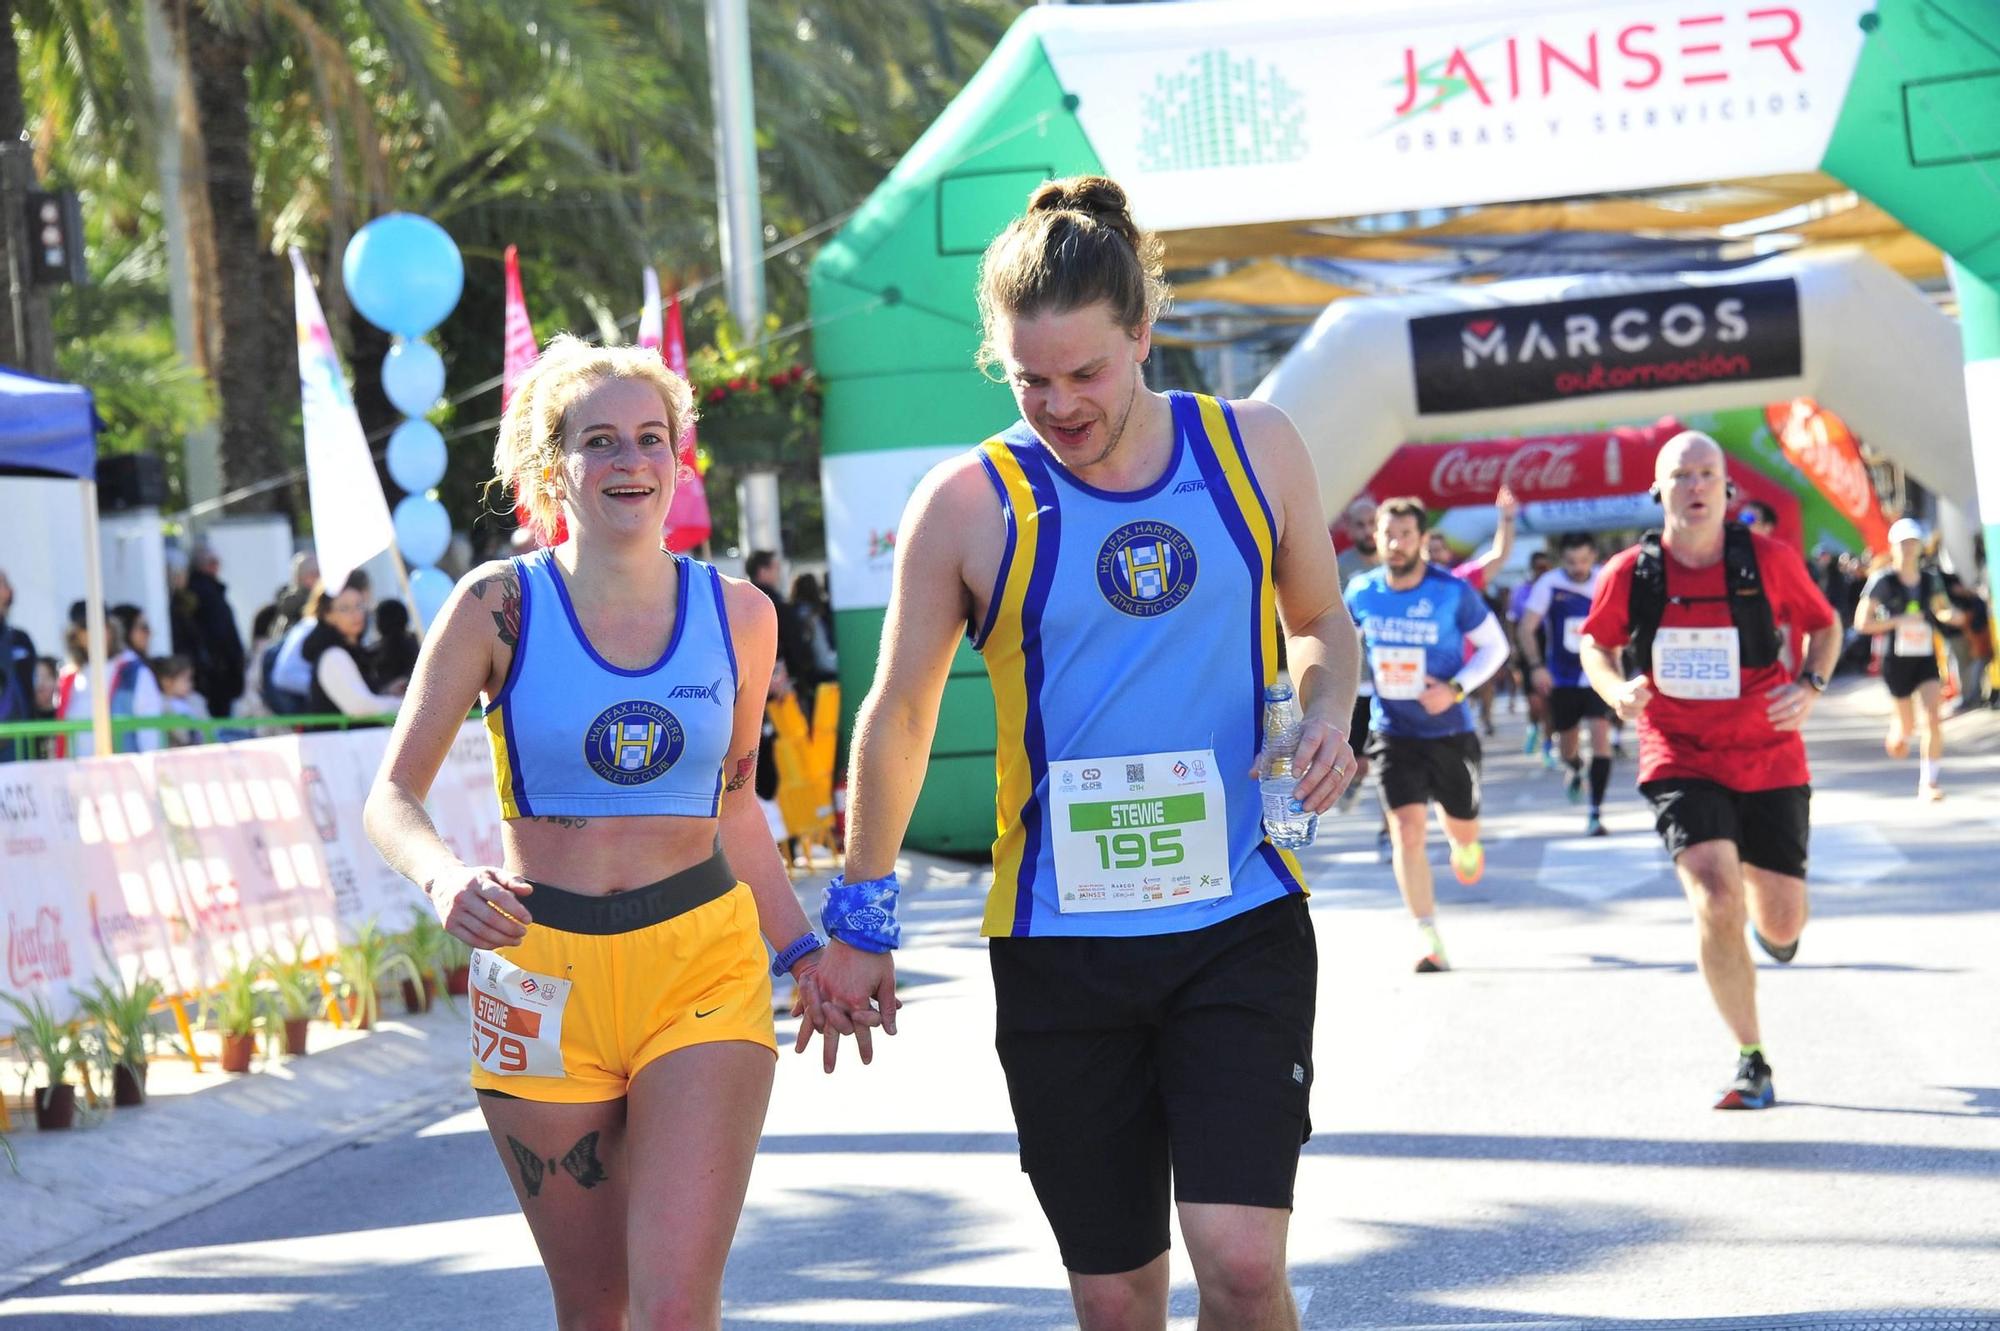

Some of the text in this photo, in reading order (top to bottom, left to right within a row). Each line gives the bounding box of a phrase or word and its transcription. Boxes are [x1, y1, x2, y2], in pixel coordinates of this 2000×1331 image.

[1394, 7, 1805, 115] JAINSER
[1394, 91, 1812, 154] OBRAS Y SERVICIOS
[1461, 298, 1748, 369] MARCOS
[1556, 352, 1751, 394] automoción
[1100, 524, 1193, 574] HALIFAX HARRIERS
[1124, 541, 1168, 597] H
[1110, 583, 1190, 615] ATHLETIC CLUB
[1661, 662, 1730, 679] 2325
[667, 678, 722, 706] FASTRAX
[588, 703, 682, 743] HALIFAX HARRIERS
[613, 721, 656, 767] H
[592, 760, 670, 784] ATHLETIC CLUB
[1110, 801, 1164, 827] STEWIE
[1095, 828, 1185, 870] 195
[478, 995, 509, 1028] STEWIE
